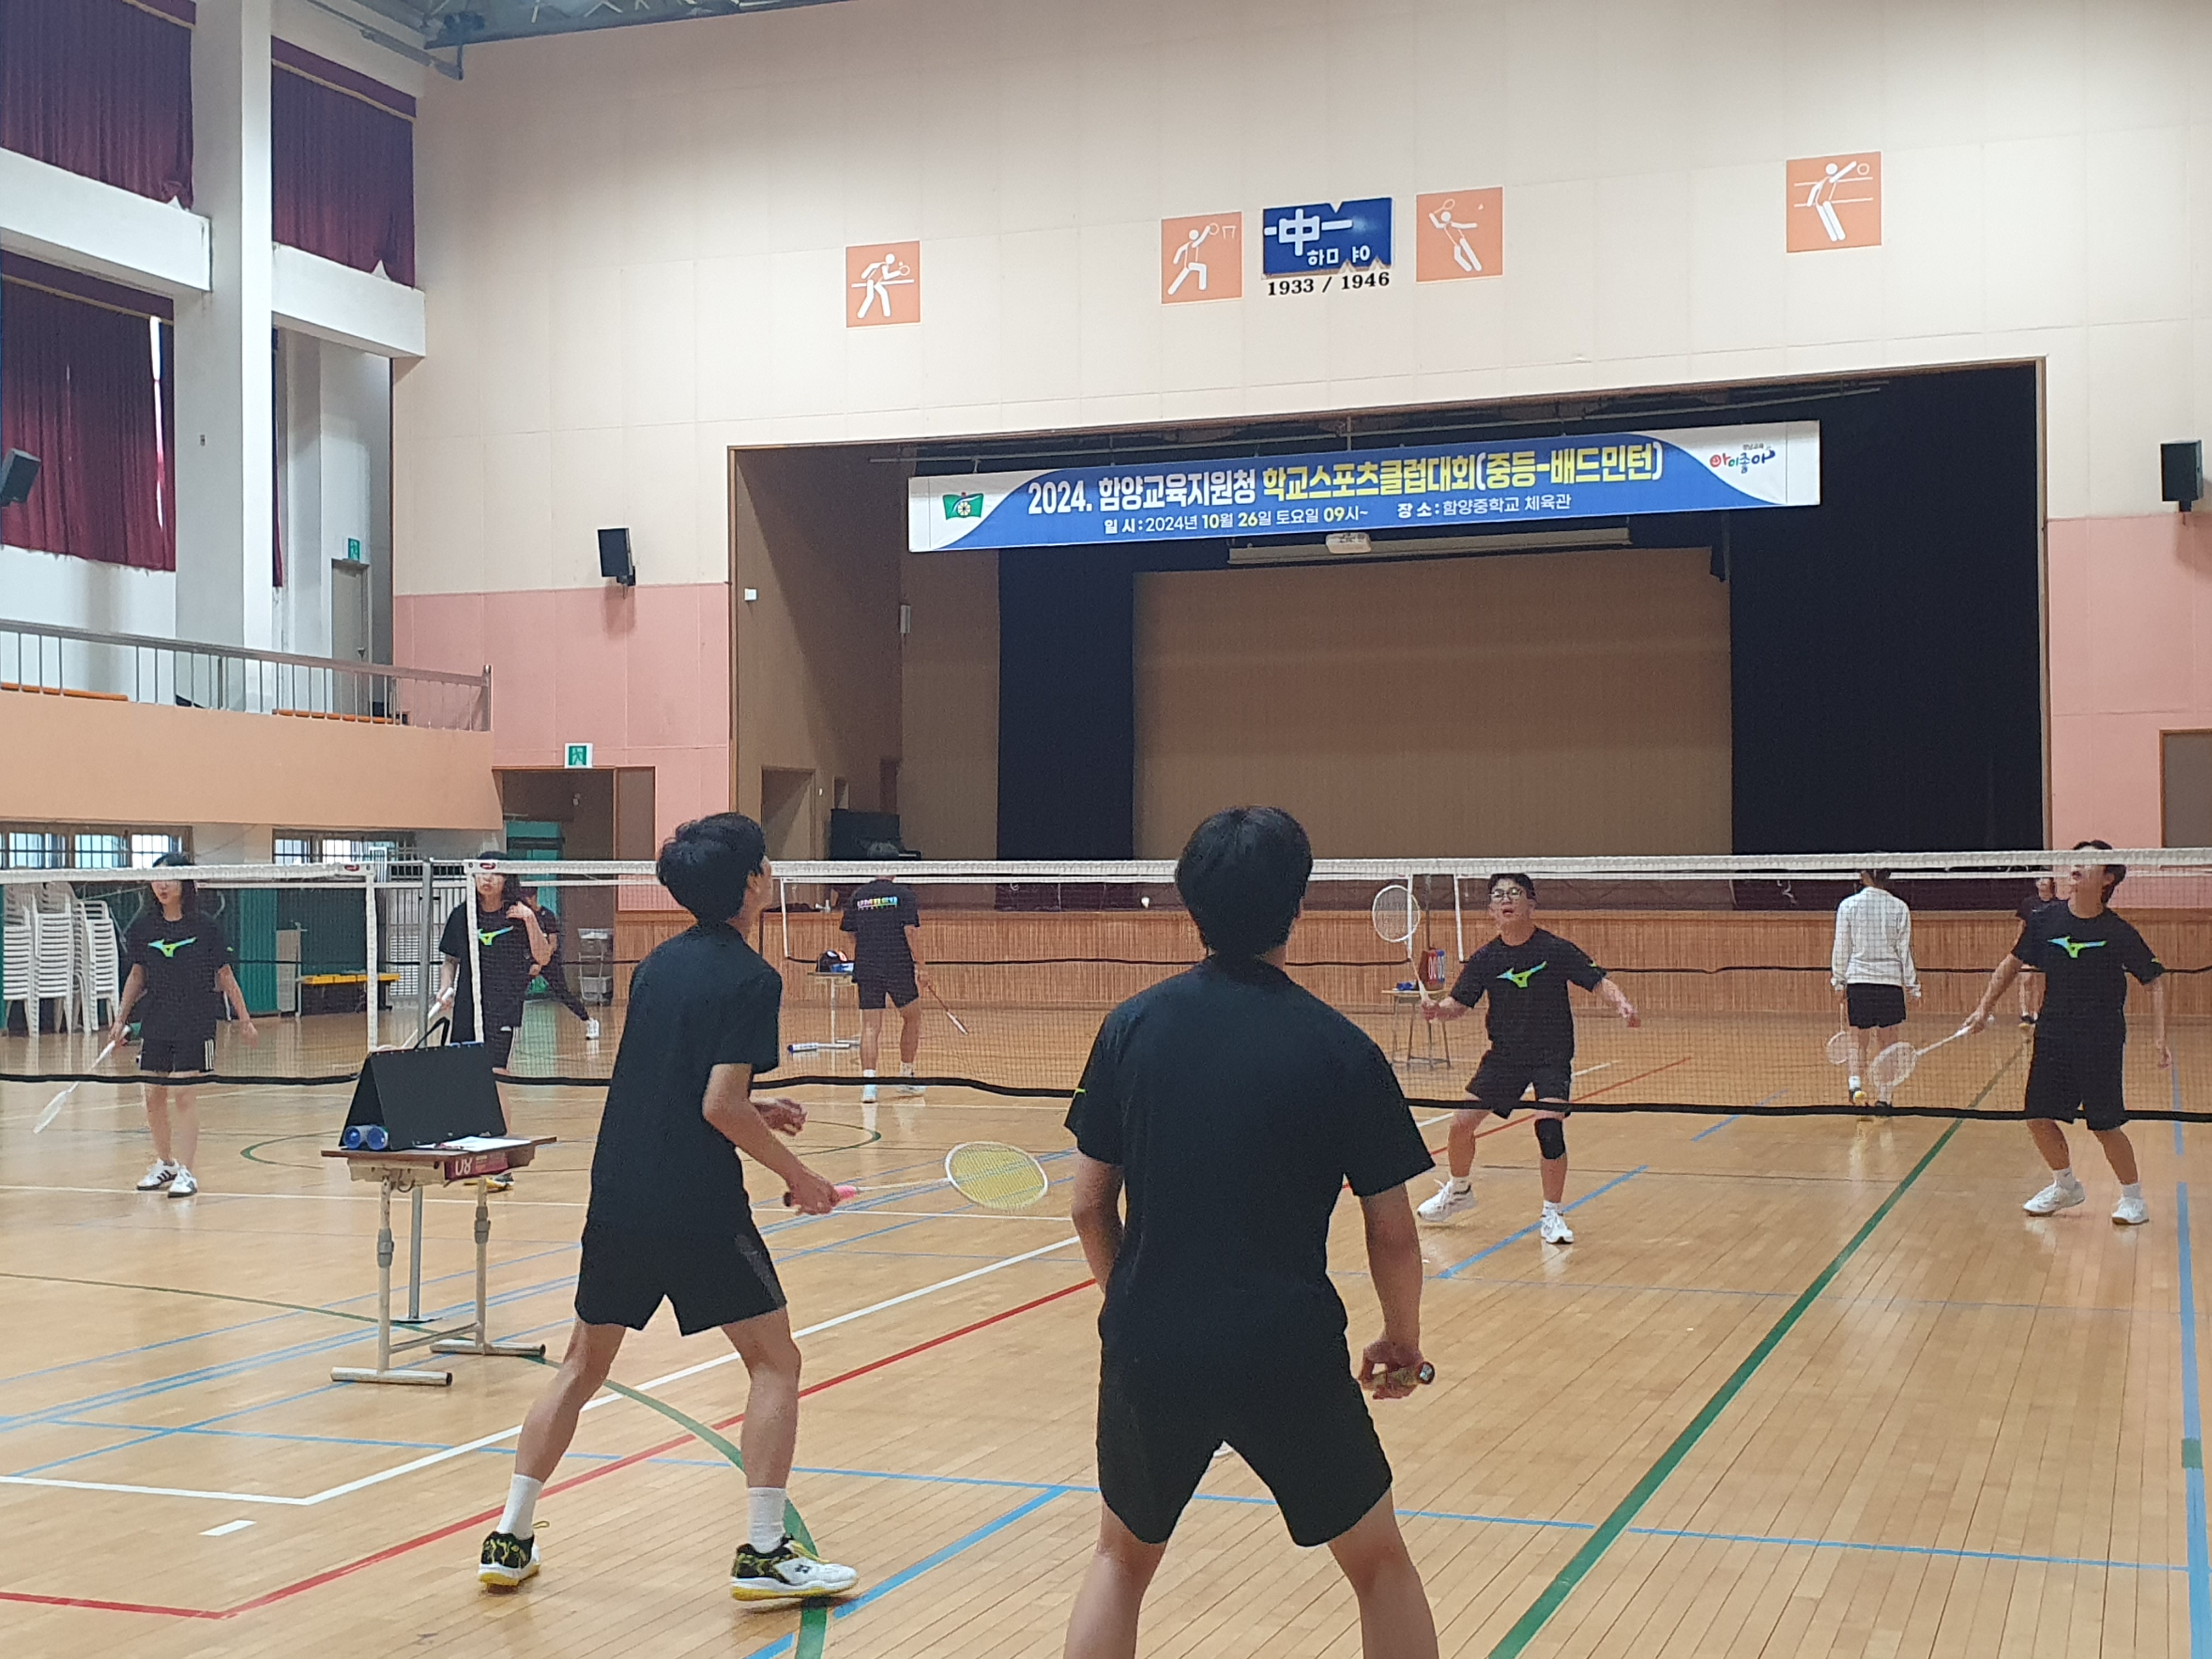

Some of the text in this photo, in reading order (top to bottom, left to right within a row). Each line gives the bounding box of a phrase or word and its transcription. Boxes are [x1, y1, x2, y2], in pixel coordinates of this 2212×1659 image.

[1268, 272, 1390, 296] 1933 / 1946
[1028, 480, 1093, 515] 2024.
[1098, 468, 1256, 512] 함양교육지원청
[1443, 497, 1520, 516] 함양중학교
[1525, 494, 1572, 511] 체육관
[1146, 515, 1198, 532] 2024년
[1202, 512, 1233, 529] 10월
[1238, 511, 1272, 527] 26일
[1276, 508, 1319, 524] 토요일
